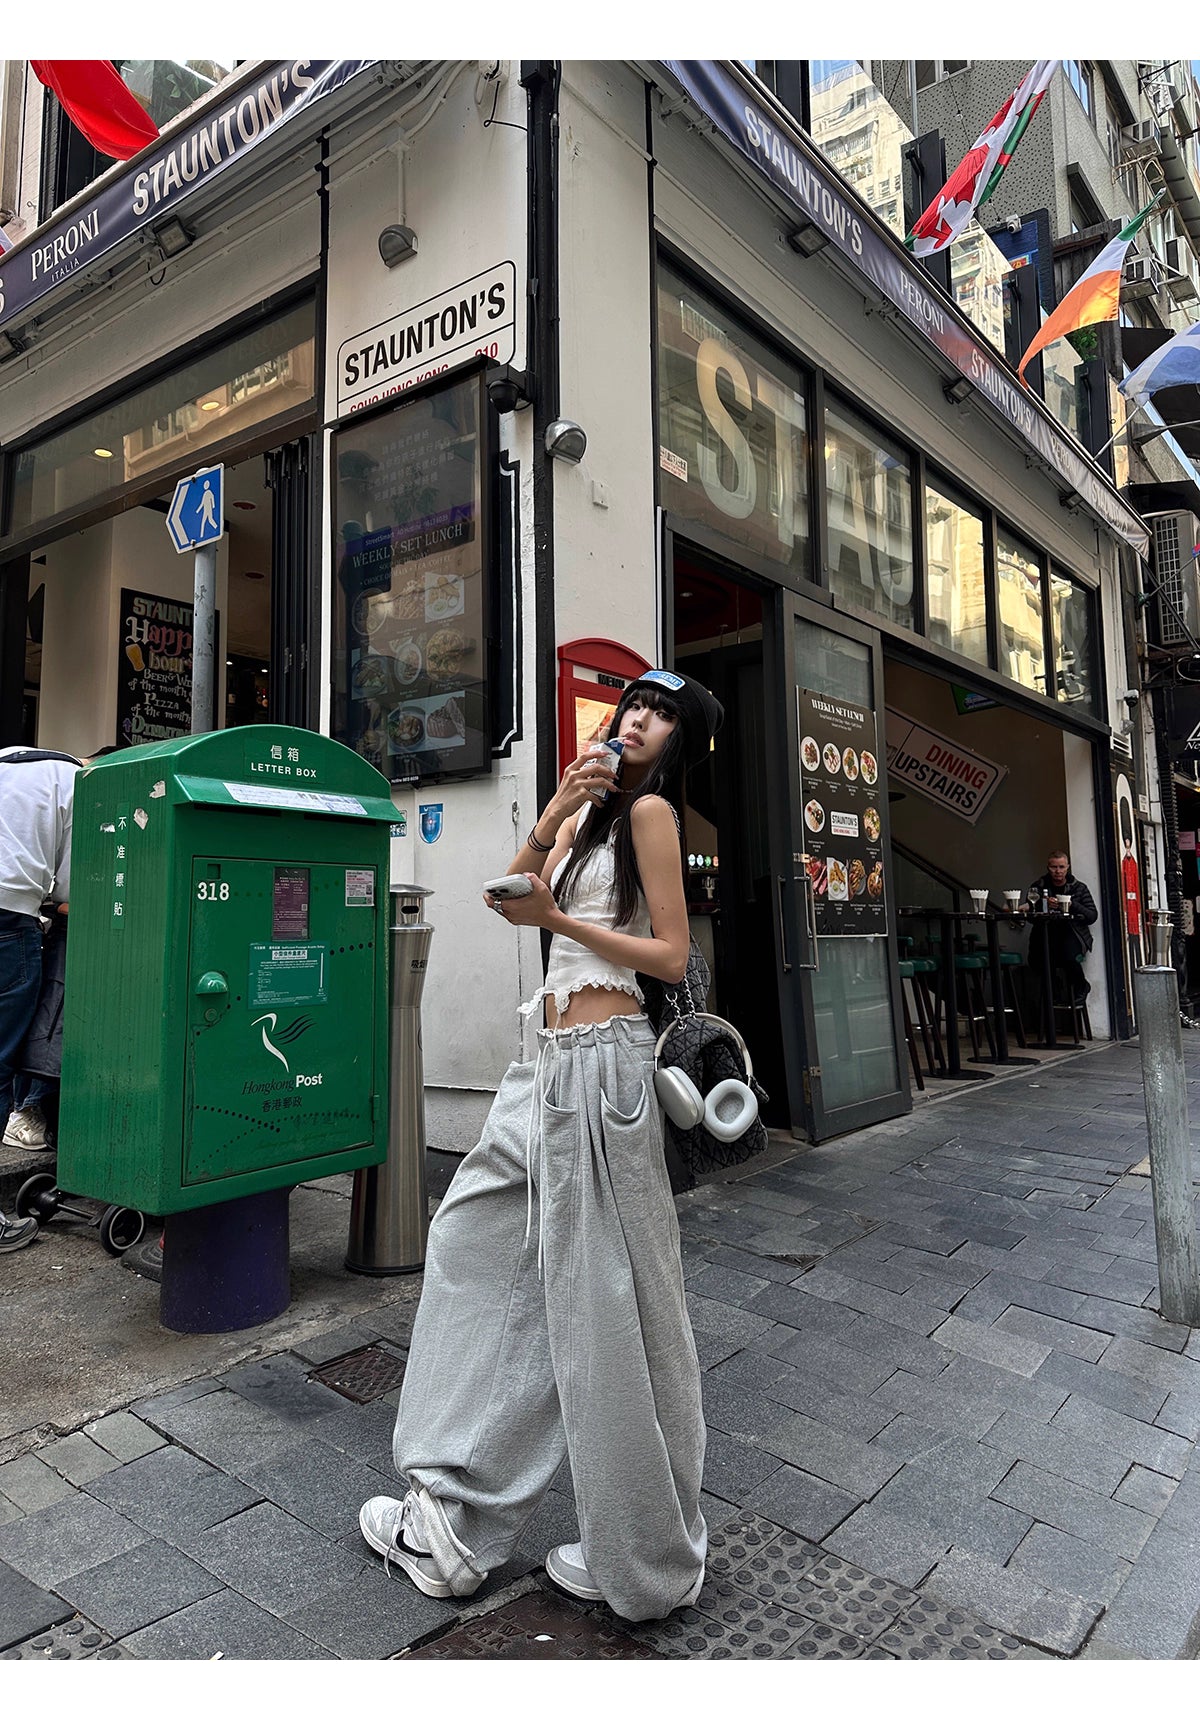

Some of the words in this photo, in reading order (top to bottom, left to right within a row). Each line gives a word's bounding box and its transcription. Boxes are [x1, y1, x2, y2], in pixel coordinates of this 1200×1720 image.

[132, 59, 316, 216] STAUNTON'S
[744, 106, 864, 256] STAUNTON'S
[31, 208, 100, 282] PERONI
[51, 257, 80, 282] ITALIA
[900, 269, 945, 336] PERONI
[345, 282, 506, 387] STAUNTON'S
[971, 349, 1033, 434] STAUNTON'S
[352, 541, 398, 568] WEEKLY
[400, 535, 423, 553] SET
[425, 523, 463, 546] LUNCH
[140, 679, 155, 691] the
[598, 673, 625, 689] MENU
[144, 705, 160, 718] the
[251, 762, 291, 775] LETTER
[296, 768, 317, 778] BOX
[270, 744, 299, 762] 信箱
[925, 744, 987, 790] DINING
[895, 751, 977, 809] UPSTAIRS
[197, 881, 230, 901] 318
[242, 1078, 295, 1095] Hongkong
[295, 1073, 323, 1087] Post
[262, 1096, 303, 1113] 香港郵政
